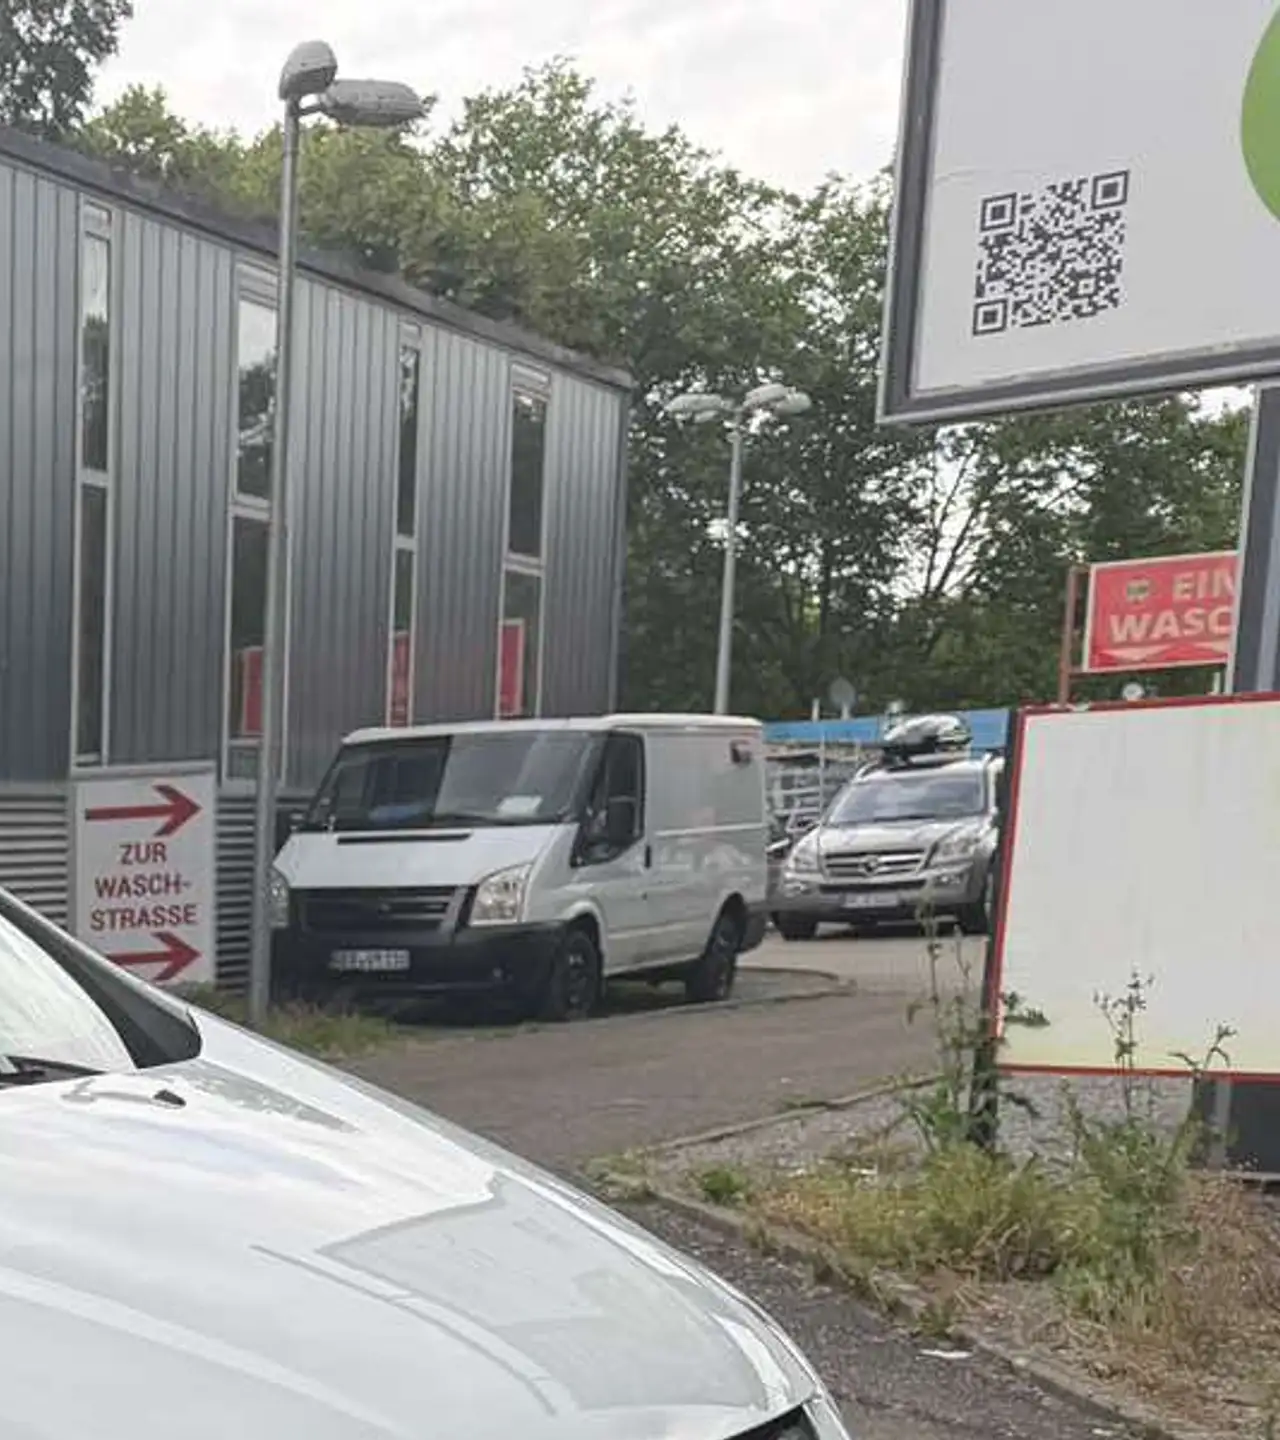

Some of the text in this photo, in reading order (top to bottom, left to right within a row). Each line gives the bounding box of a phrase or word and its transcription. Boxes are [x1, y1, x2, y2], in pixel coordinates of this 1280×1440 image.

[119, 841, 168, 866] ZUR
[94, 872, 193, 899] WASCH-
[90, 903, 198, 932] STRASSE
